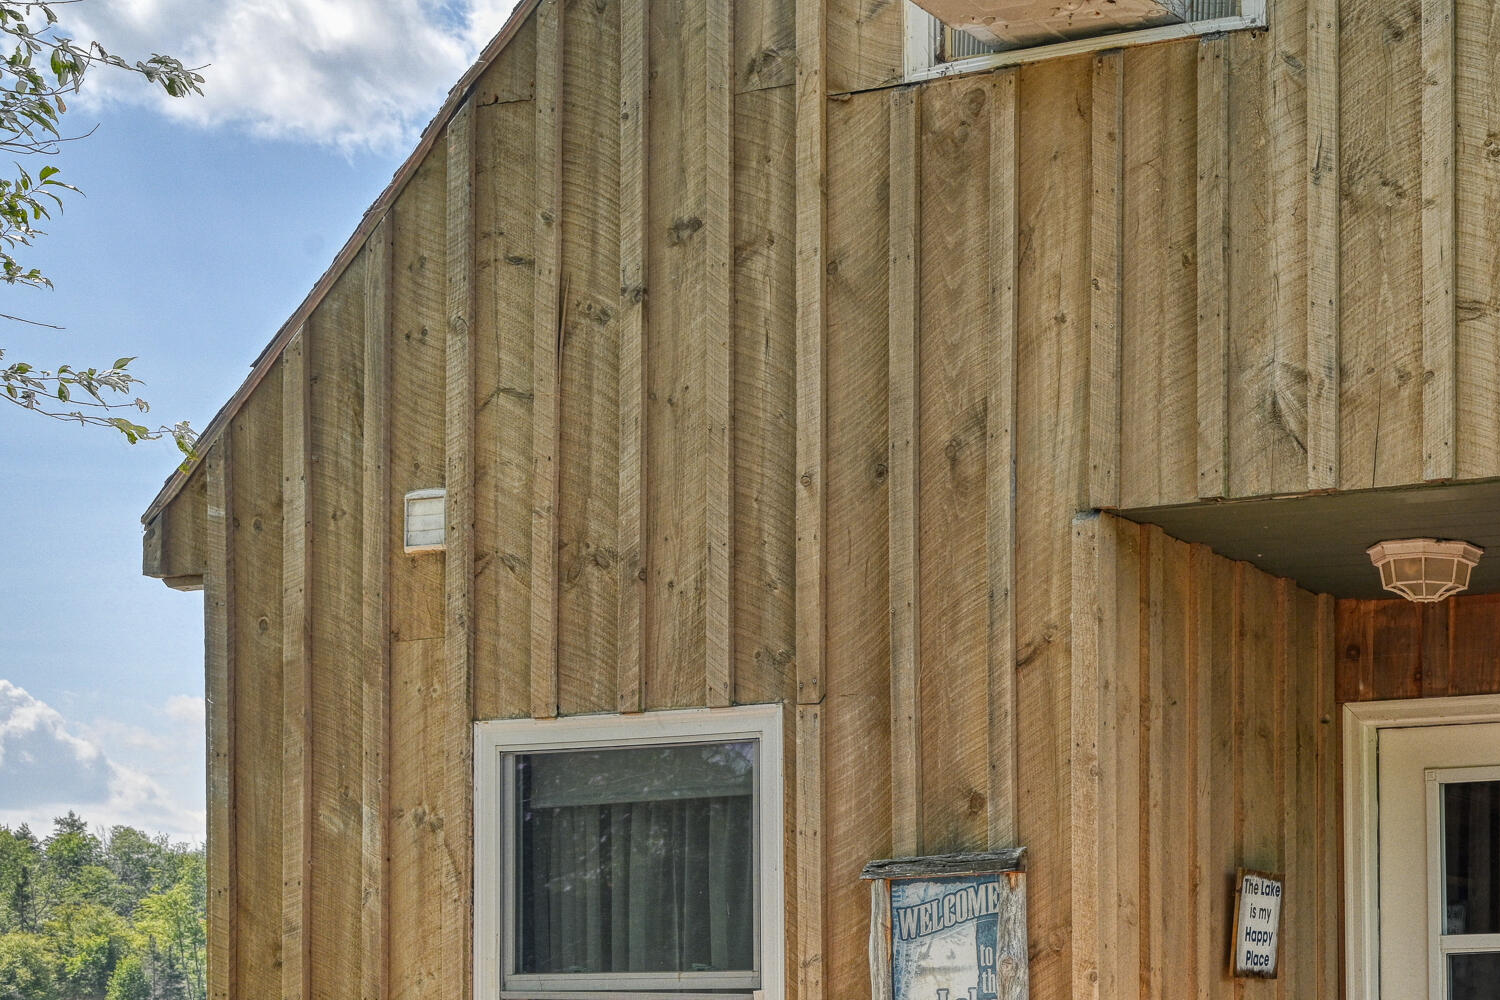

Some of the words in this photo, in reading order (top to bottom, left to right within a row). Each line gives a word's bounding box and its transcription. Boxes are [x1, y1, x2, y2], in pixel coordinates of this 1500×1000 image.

[1245, 879, 1259, 895] The
[1260, 881, 1280, 897] Lake
[898, 881, 1000, 941] WELCOME
[1249, 903, 1256, 919] is
[1259, 907, 1271, 923] my
[1245, 926, 1273, 946] Happy
[980, 944, 993, 966] to
[1246, 950, 1269, 966] Place
[982, 969, 996, 993] th
